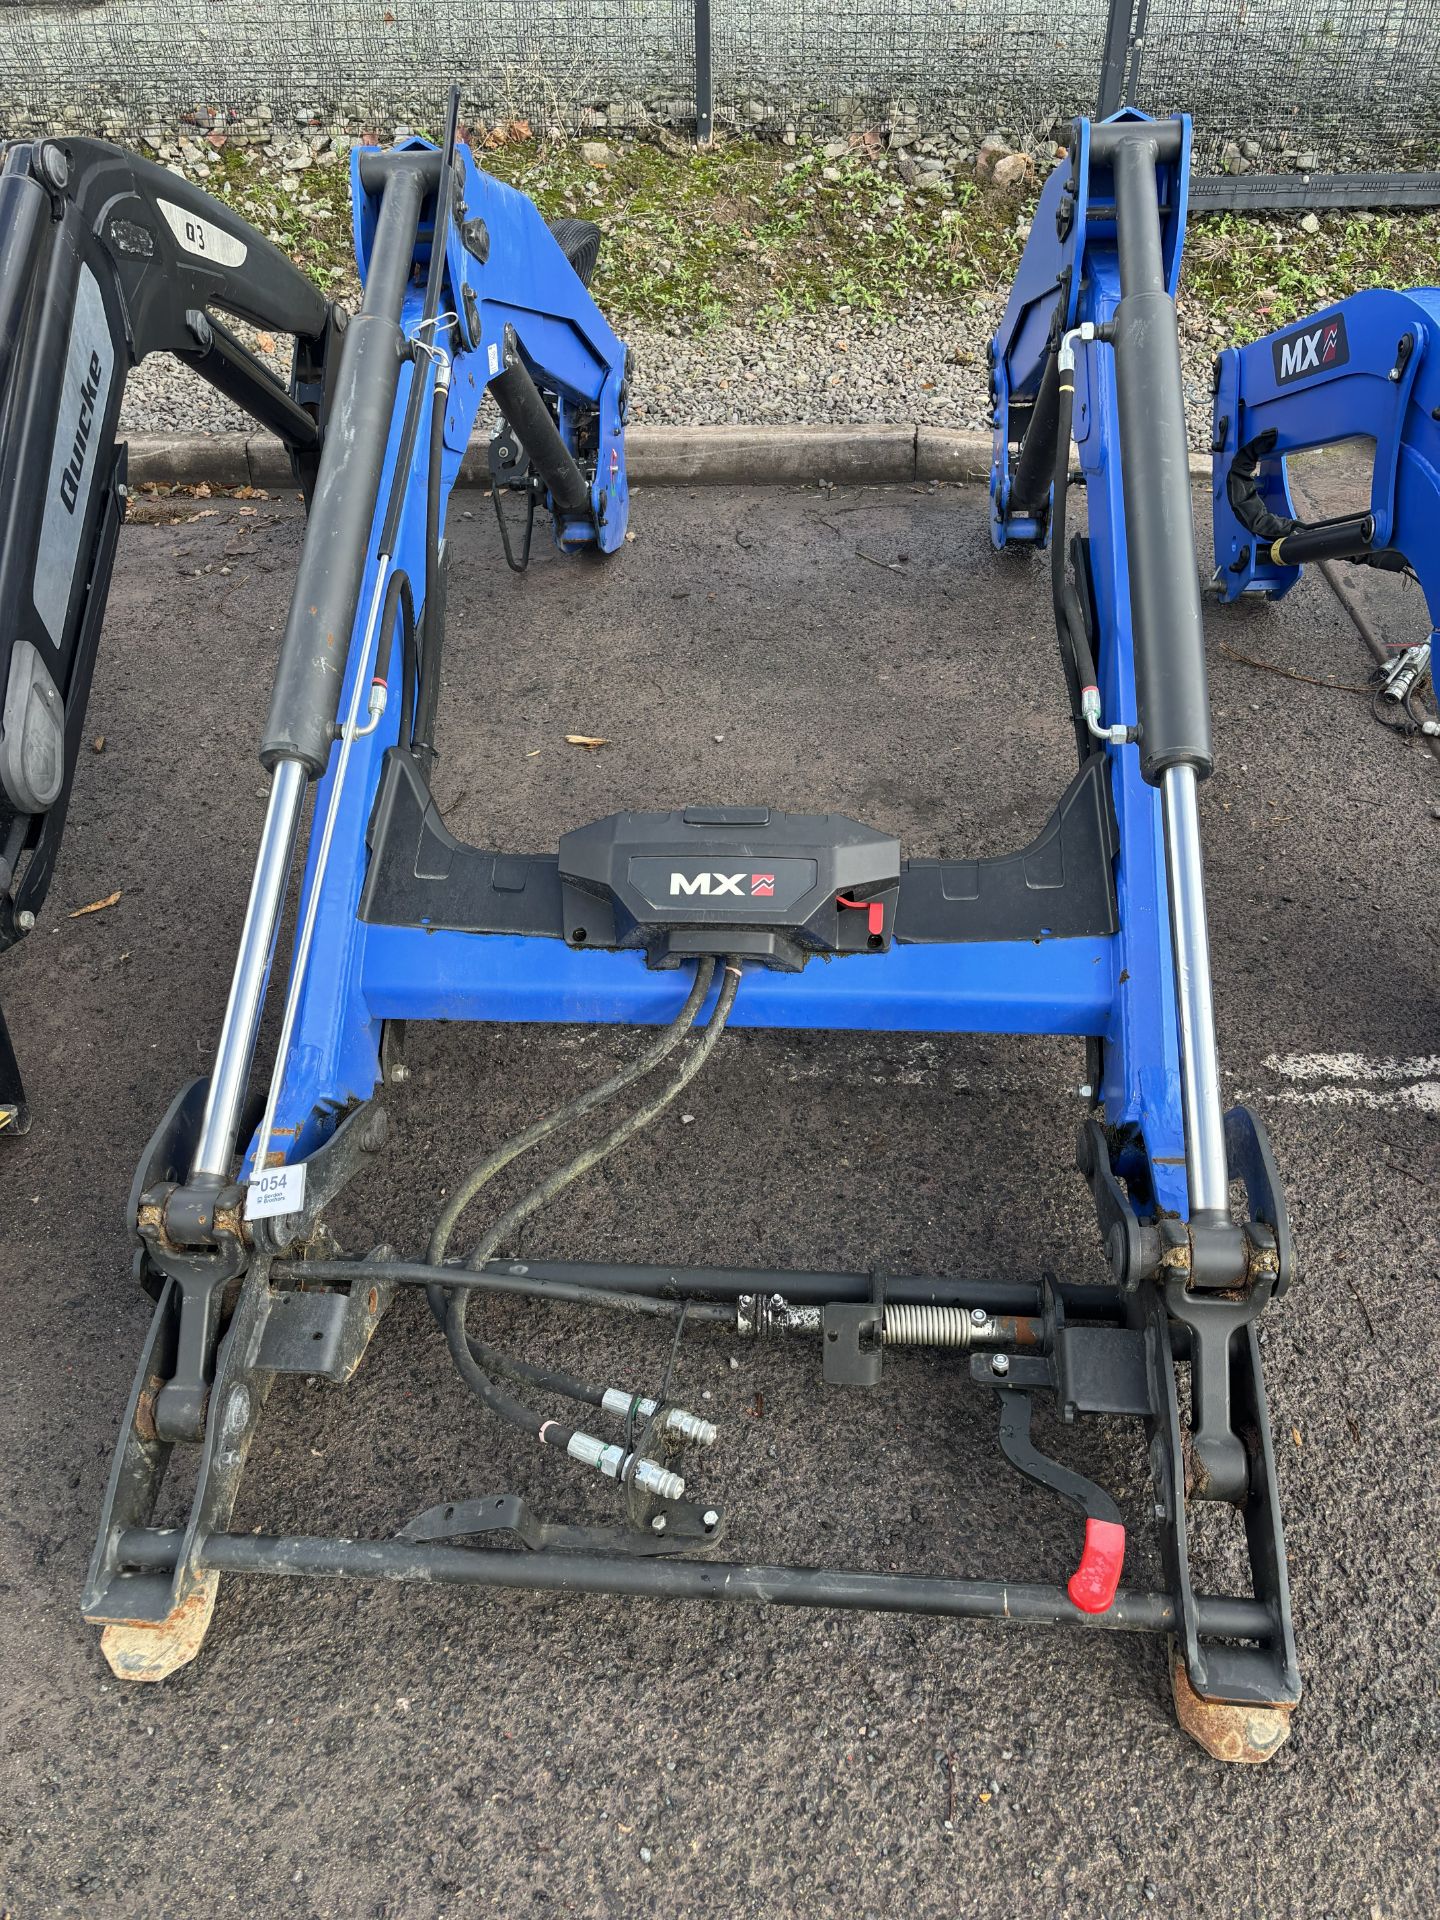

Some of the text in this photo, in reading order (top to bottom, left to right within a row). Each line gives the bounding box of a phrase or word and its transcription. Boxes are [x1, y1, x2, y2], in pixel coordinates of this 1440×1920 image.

[1281, 329, 1322, 379] MX
[60, 350, 102, 515] Quicke
[670, 873, 748, 895] MX
[260, 1174, 287, 1192] 054
